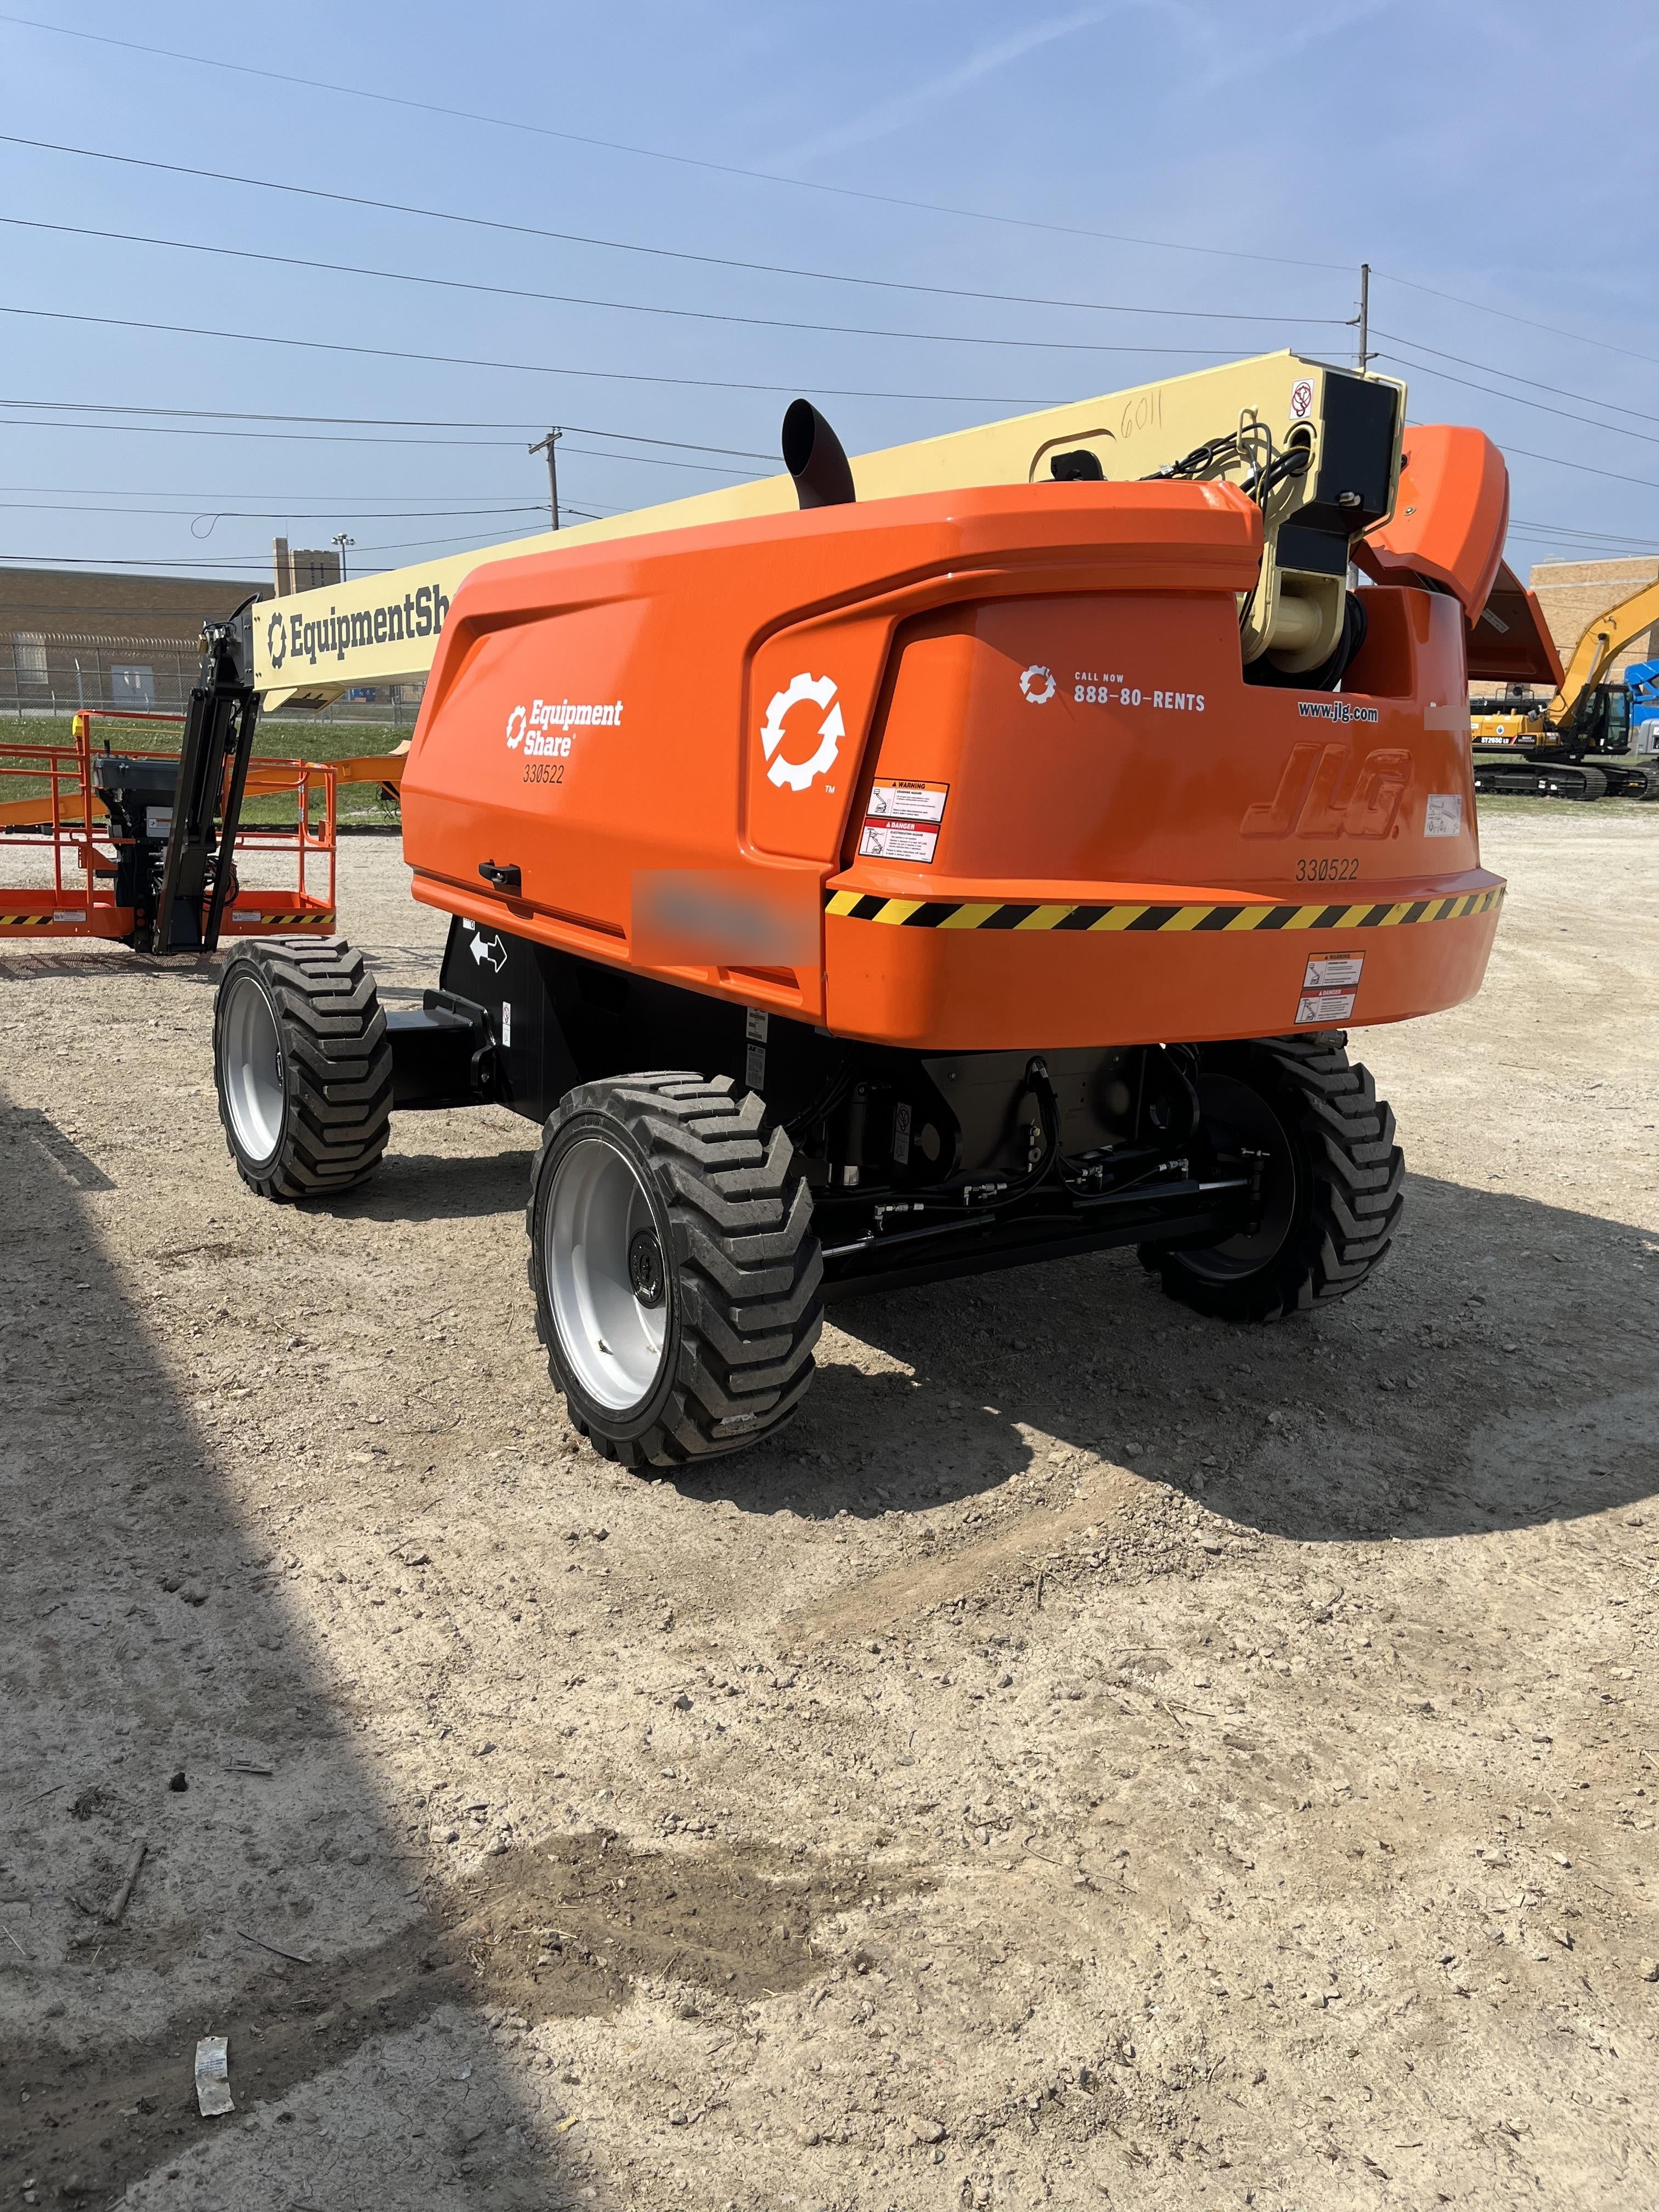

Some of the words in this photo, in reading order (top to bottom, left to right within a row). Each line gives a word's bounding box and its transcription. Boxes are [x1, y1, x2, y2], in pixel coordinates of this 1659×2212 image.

[1121, 388, 1162, 438] 6011
[1075, 672, 1098, 681] CALL
[1103, 673, 1124, 683] NOW
[1074, 685, 1205, 712] 888-80-RENTS
[529, 698, 624, 731] Equipment
[1298, 701, 1379, 723] www.jlg.com
[524, 730, 572, 757] Share
[523, 764, 565, 783] 330522
[825, 785, 836, 794] TM
[1239, 742, 1413, 840] JLG
[891, 822, 916, 830] DANGER
[1296, 859, 1359, 881] 330522
